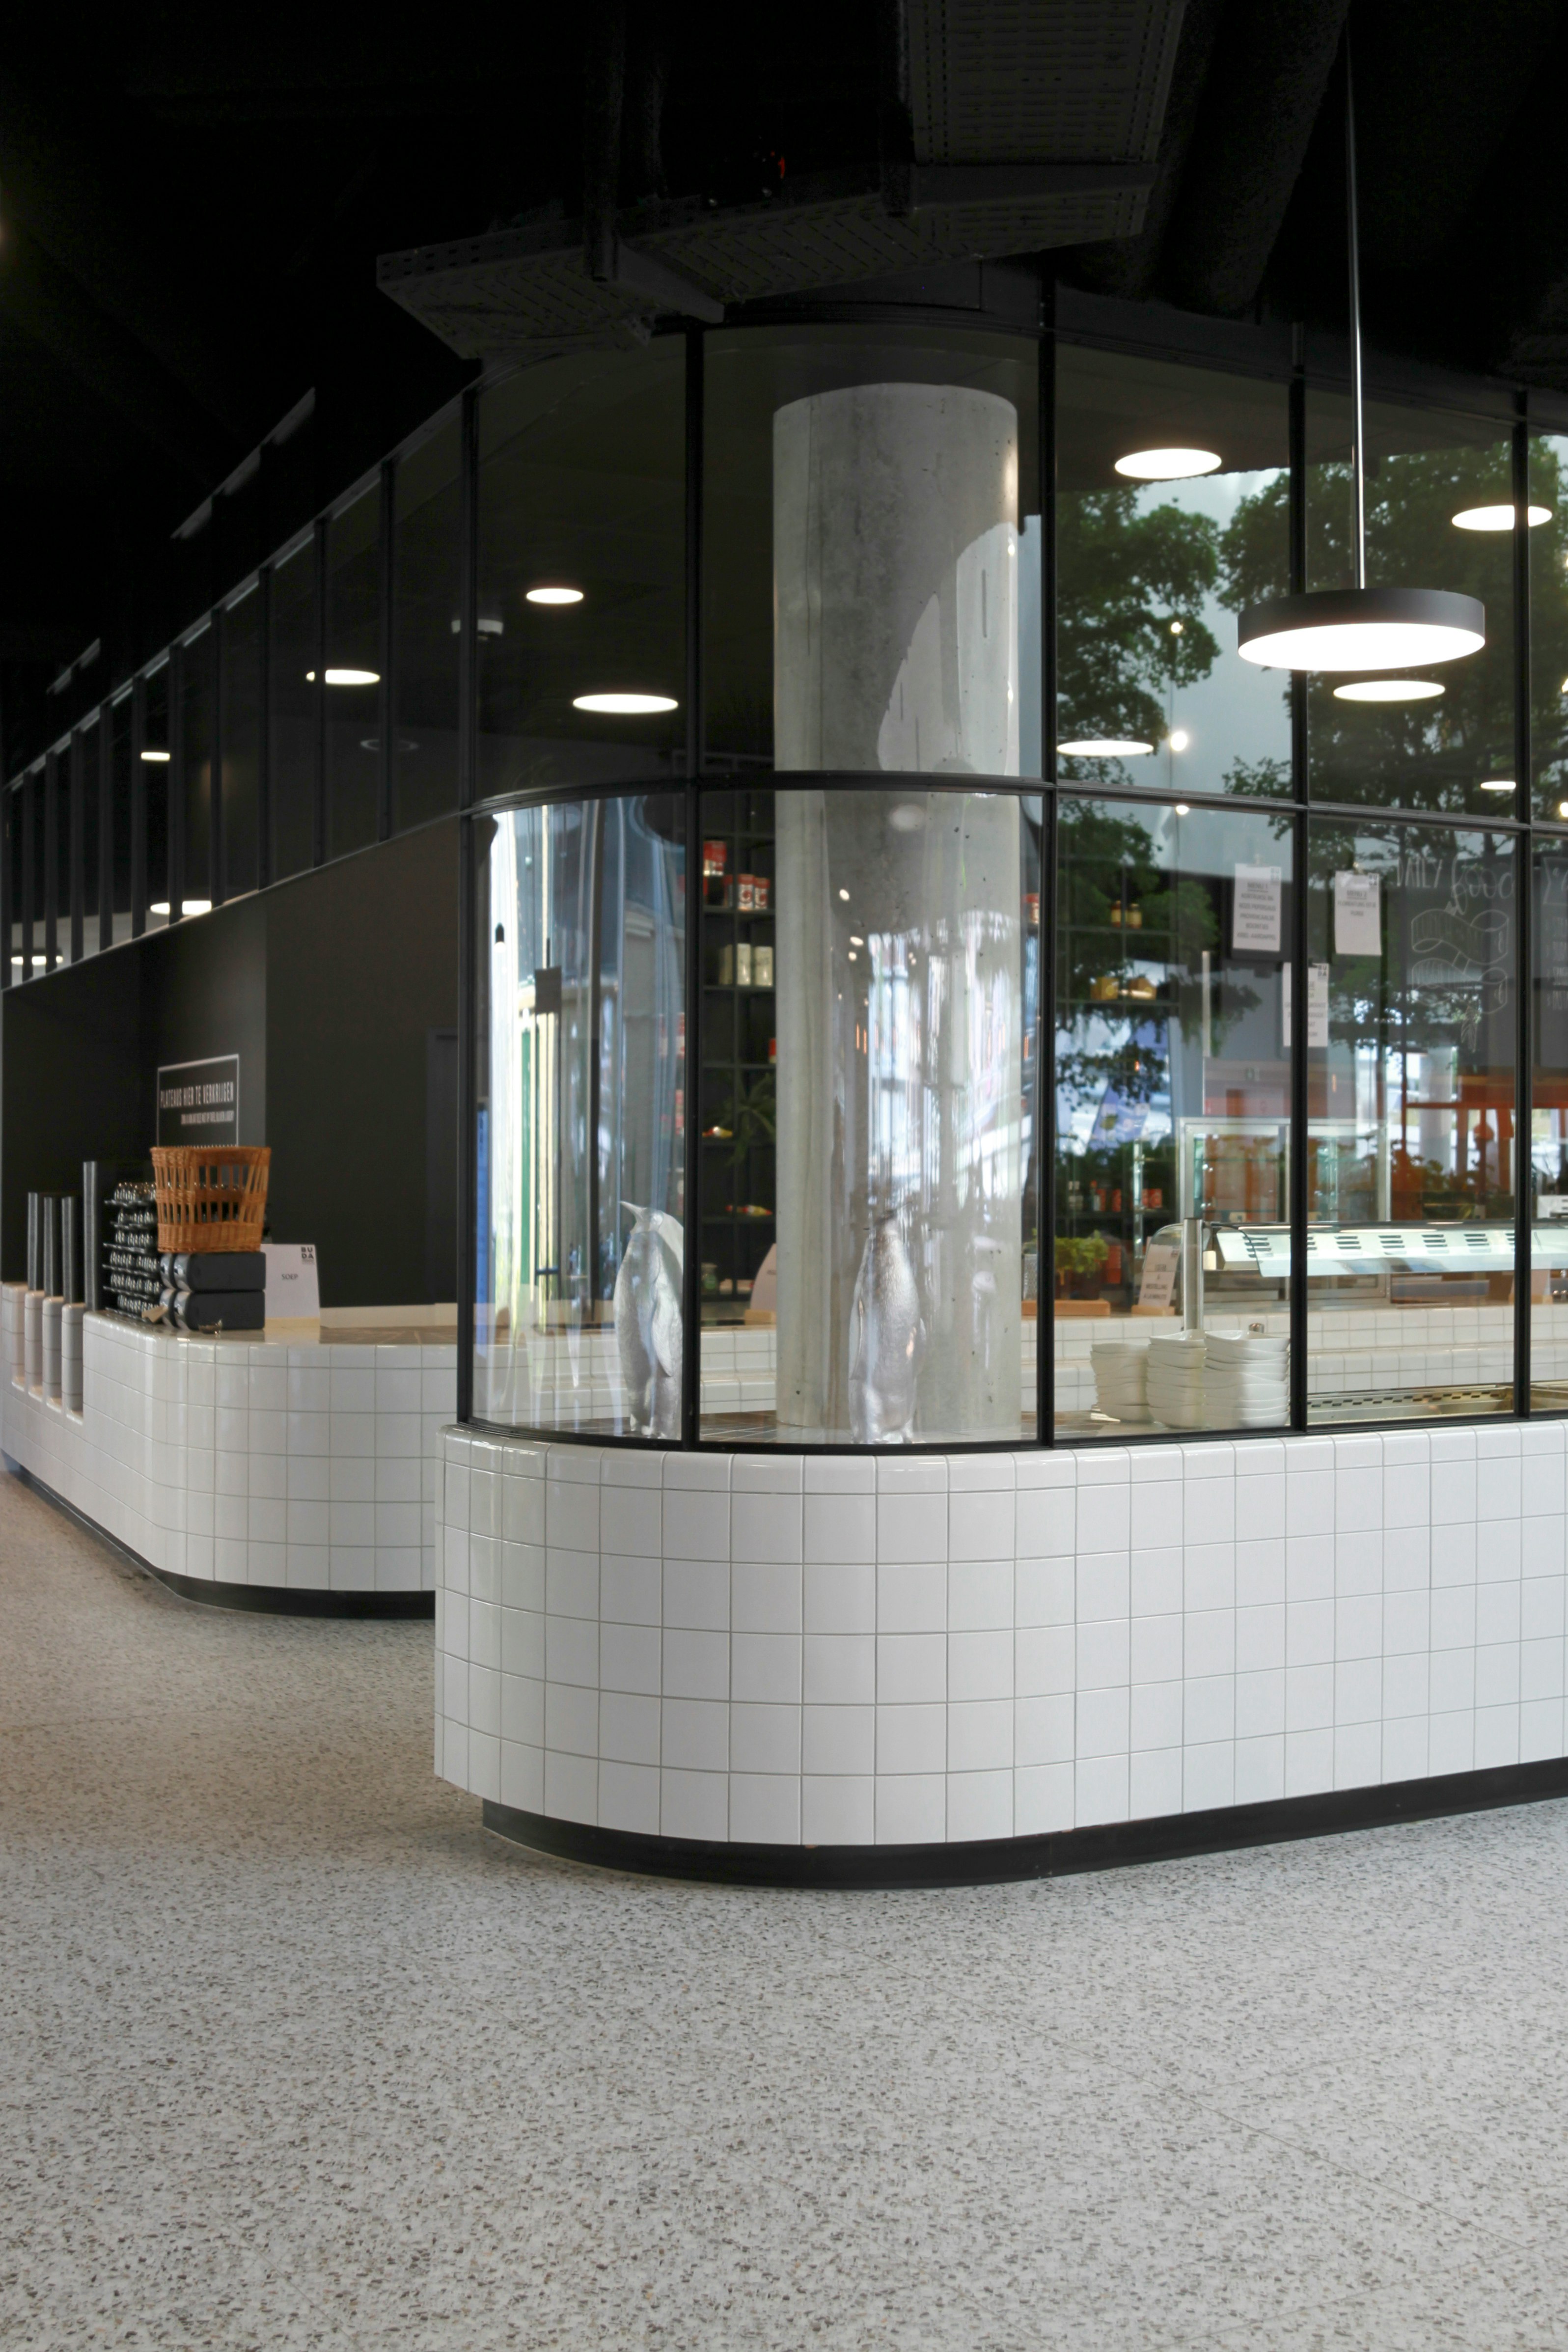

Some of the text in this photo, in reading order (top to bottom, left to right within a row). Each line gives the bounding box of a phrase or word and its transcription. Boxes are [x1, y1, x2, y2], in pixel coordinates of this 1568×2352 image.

[1397, 856, 1443, 888] DAILY
[160, 1081, 234, 1108] PLATEAUS HIER TE VERKRIJGEN
